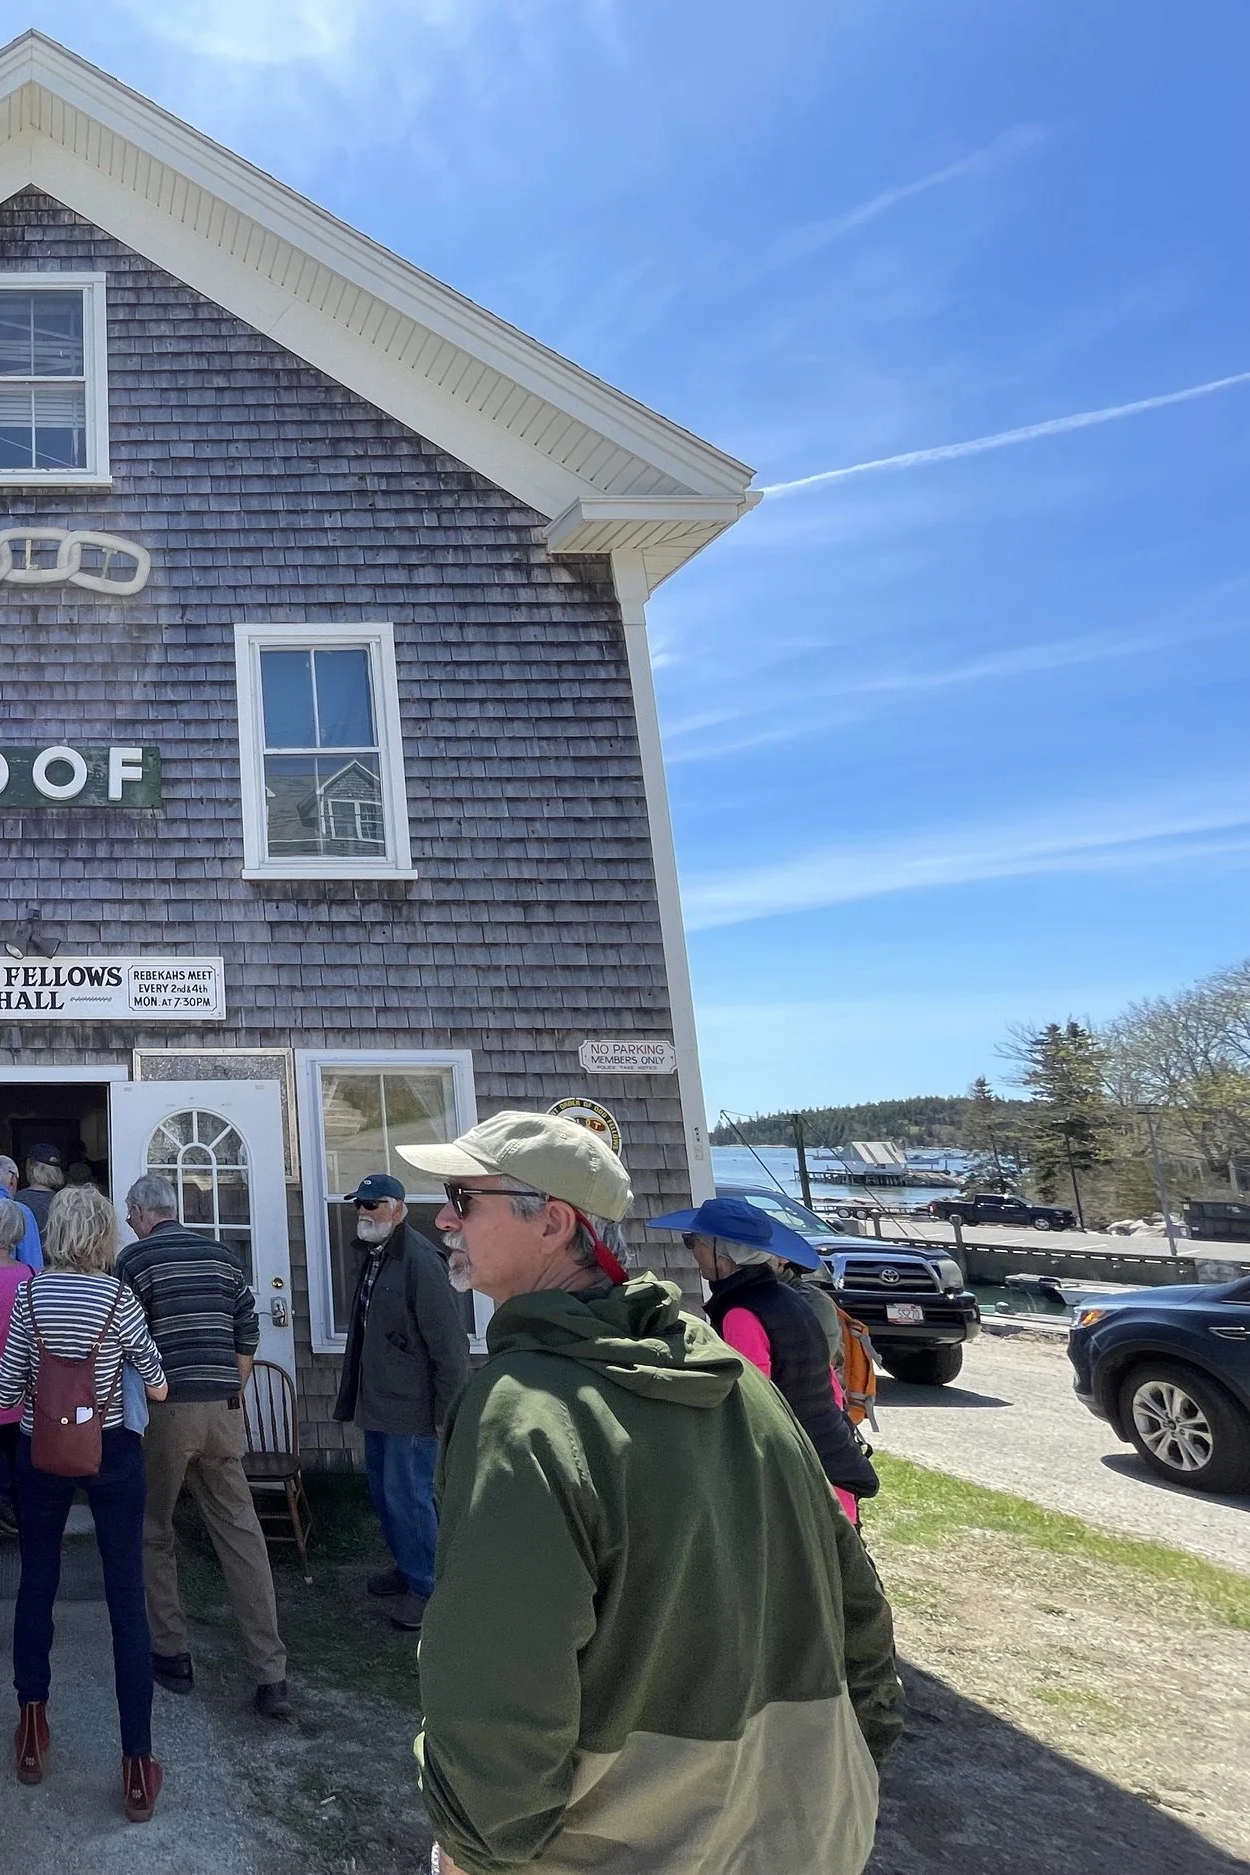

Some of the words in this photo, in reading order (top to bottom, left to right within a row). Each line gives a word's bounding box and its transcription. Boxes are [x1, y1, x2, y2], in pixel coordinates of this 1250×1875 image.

[24, 540, 39, 570] L
[4, 966, 123, 987] FELLOWS
[133, 971, 185, 980] REBEKAHS
[187, 970, 212, 980] MEET
[138, 984, 169, 993] EVERY
[162, 998, 172, 1006] AT
[591, 1044, 609, 1054] NO
[613, 1044, 664, 1054] PARKING
[591, 1056, 637, 1064] MEMBERS
[641, 1056, 665, 1065] ONLY
